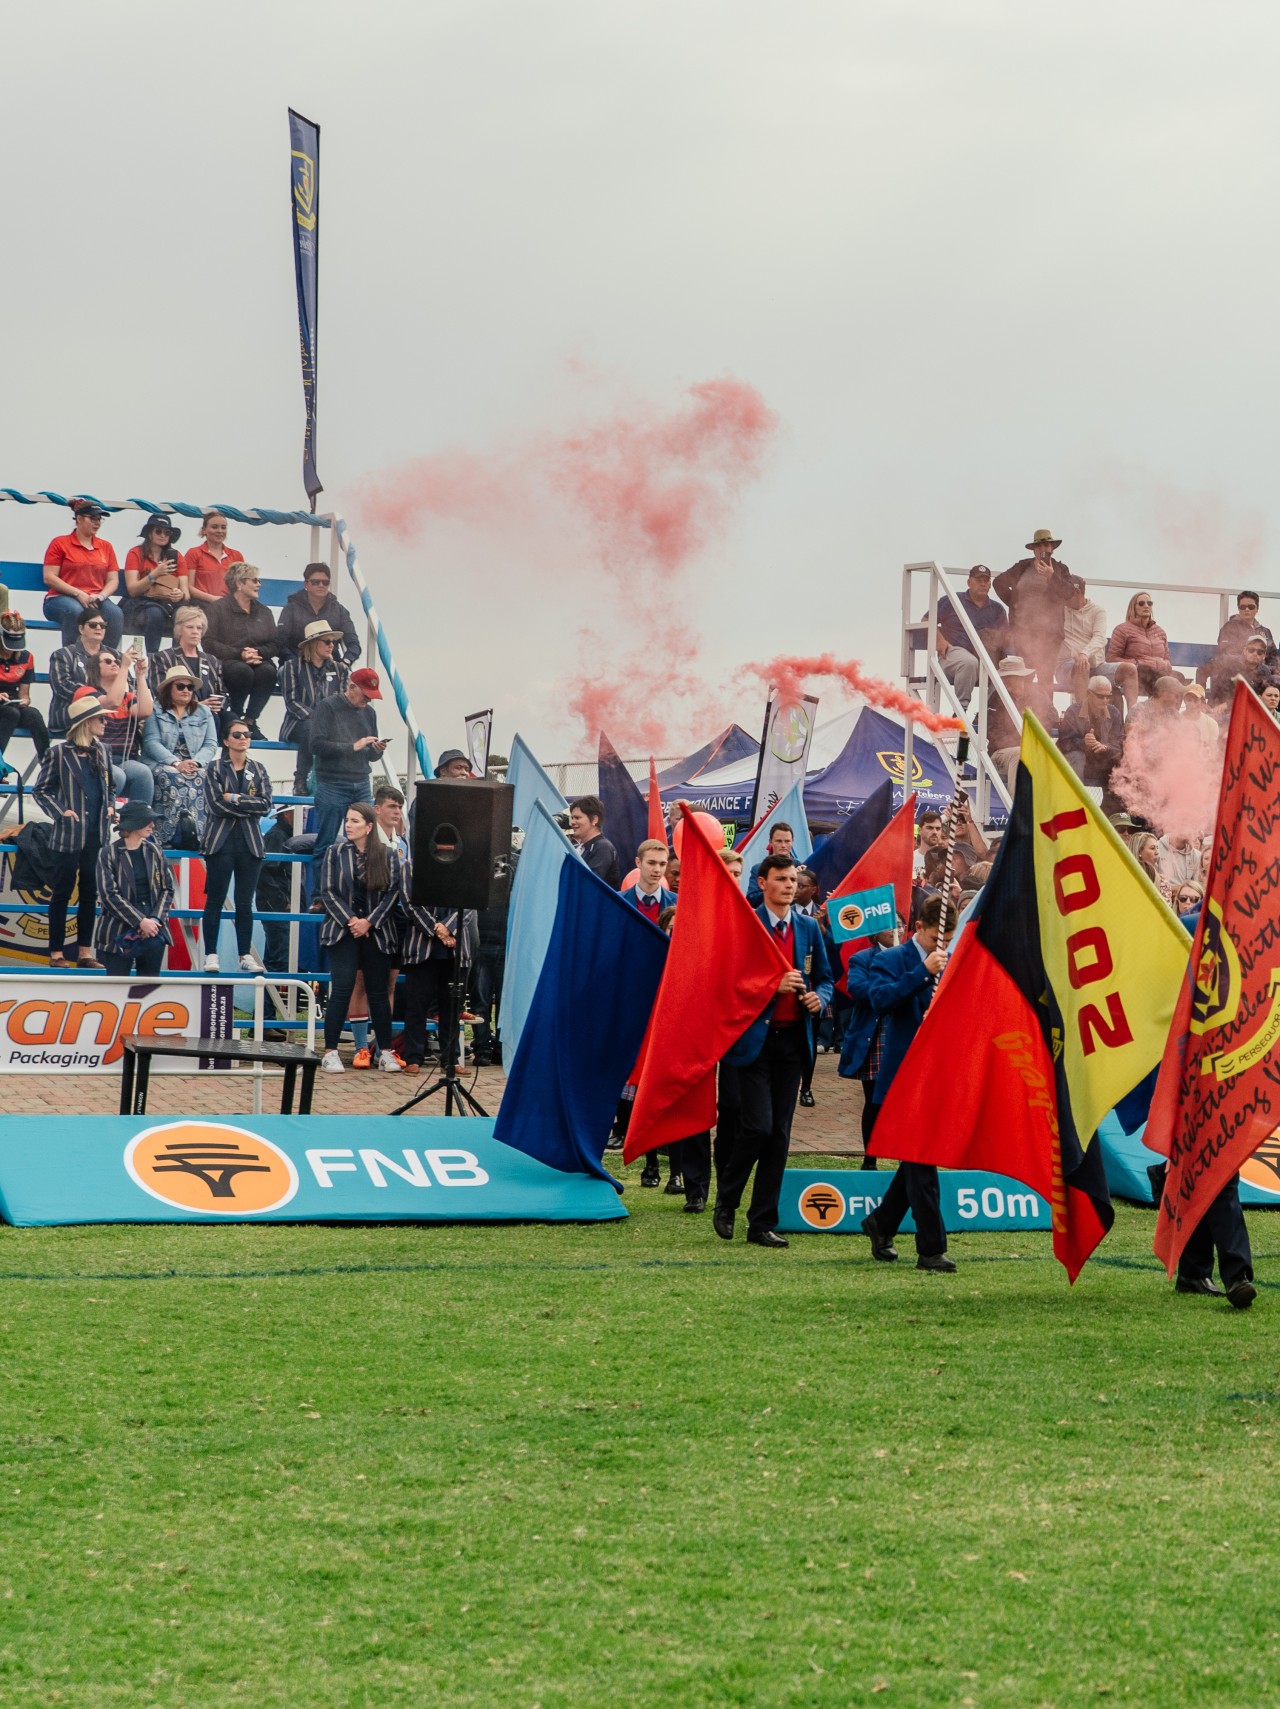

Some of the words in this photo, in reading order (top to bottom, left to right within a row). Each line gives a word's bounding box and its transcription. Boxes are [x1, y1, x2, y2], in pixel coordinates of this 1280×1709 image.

[660, 796, 741, 813] PEMANCE
[864, 902, 892, 919] FNB
[9, 1050, 101, 1068] Packaging
[305, 1149, 490, 1187] FNB
[849, 1196, 882, 1215] FN
[957, 1187, 1040, 1219] 50m
